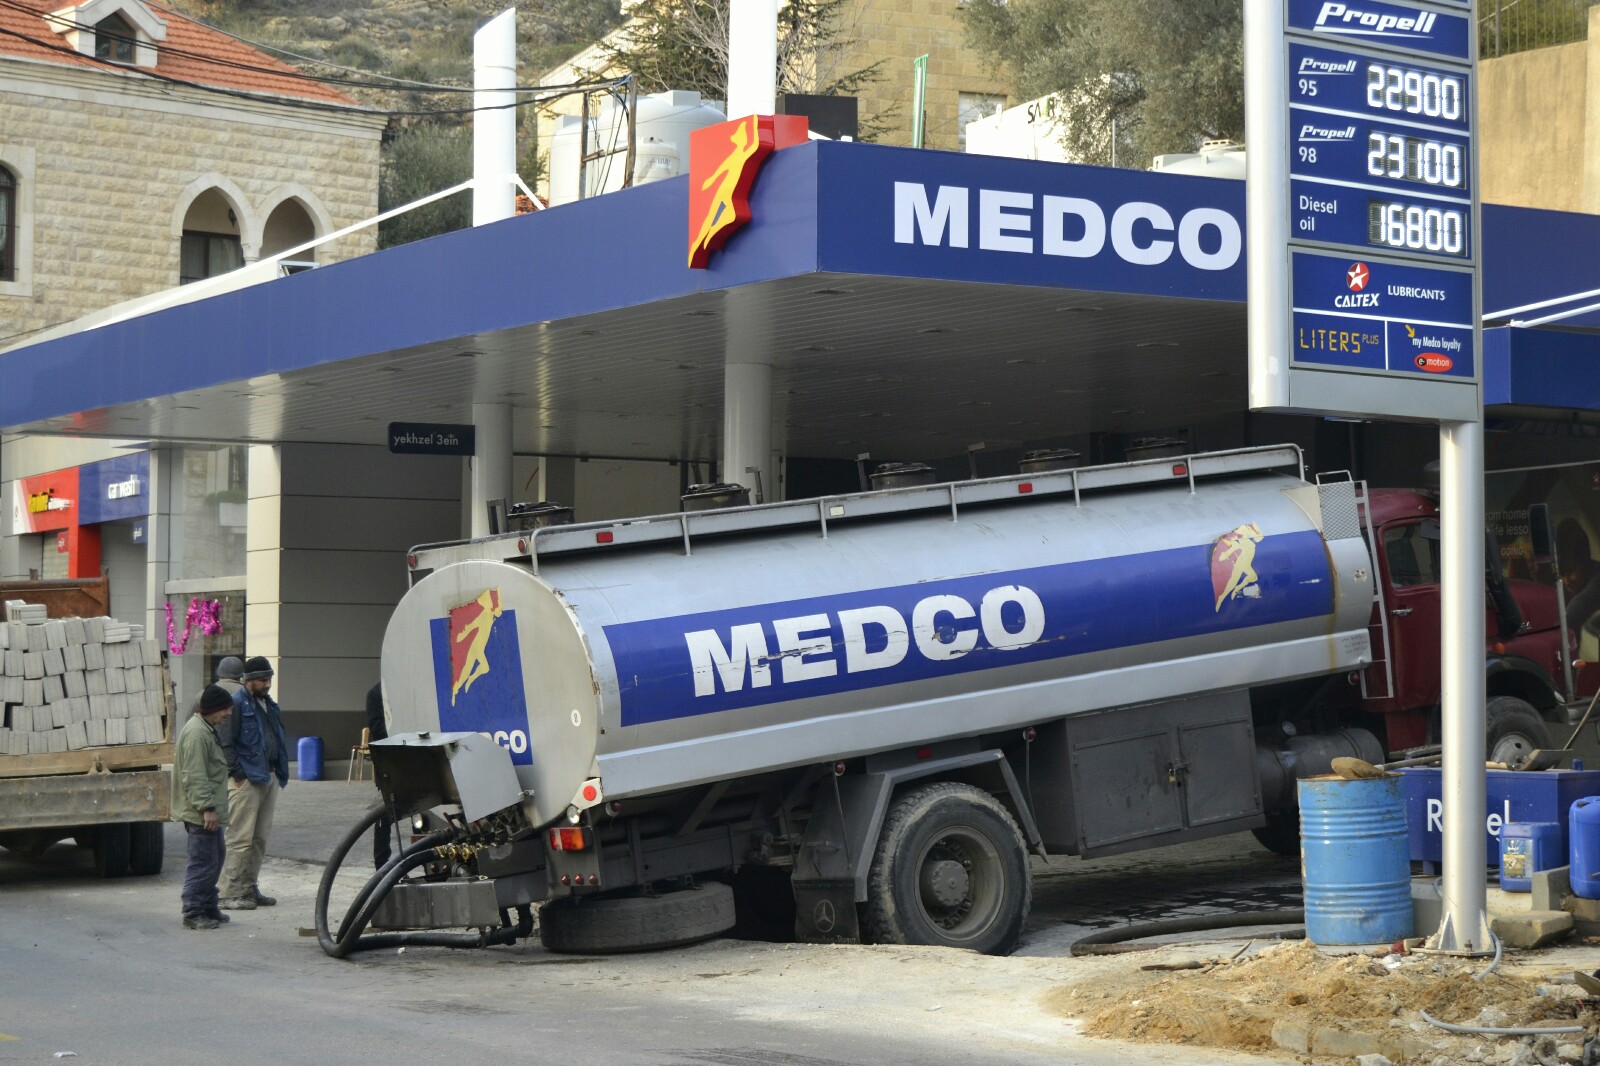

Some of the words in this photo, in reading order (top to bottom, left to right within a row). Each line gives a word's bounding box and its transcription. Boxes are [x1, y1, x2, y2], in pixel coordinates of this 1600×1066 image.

[1316, 2, 1437, 33] Propell
[1299, 57, 1357, 73] Propell
[1298, 78, 1318, 97] 95
[1367, 65, 1460, 120] 22900
[1299, 125, 1357, 140] Propell
[1298, 146, 1318, 164] 98
[1367, 133, 1461, 187] 23100
[1299, 195, 1338, 215] Diesel
[894, 181, 1242, 271] MEDCO
[1299, 216, 1316, 232] oil
[1379, 204, 1462, 253] 16800
[1334, 293, 1380, 308] CALTEX
[1387, 284, 1446, 301] LUBRICANTS
[1300, 327, 1361, 353] LITERS
[1361, 333, 1380, 345] PLUS
[1412, 337, 1422, 349] my
[1422, 336, 1441, 348] Medco
[1441, 337, 1462, 352] loyalty
[1485, 511, 1501, 521] rom
[1506, 523, 1529, 536] lesso
[685, 585, 1045, 697] MEDCO
